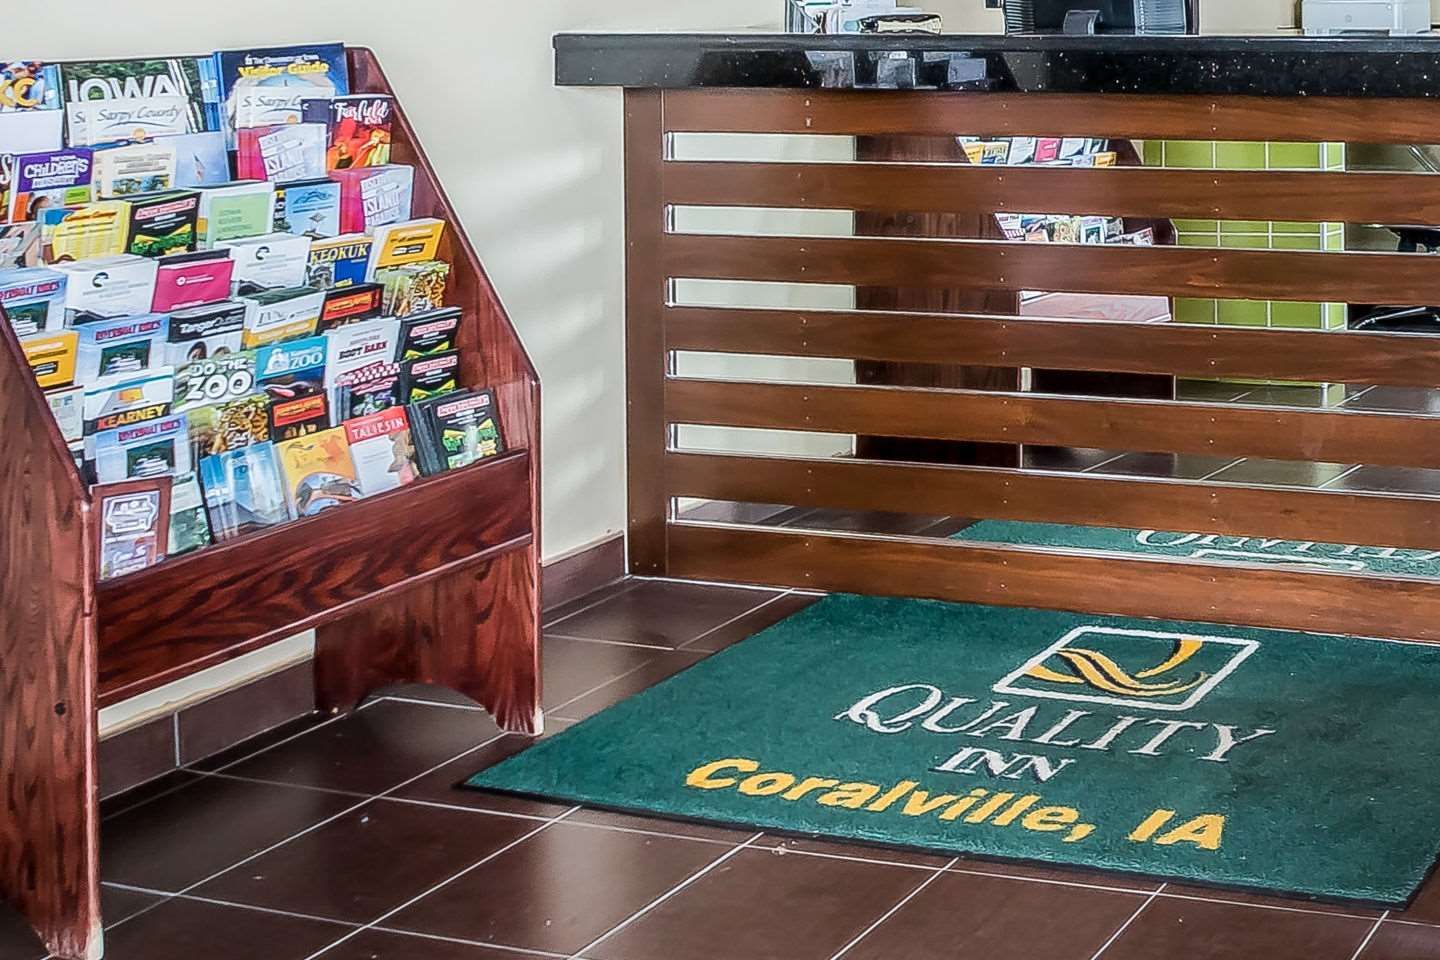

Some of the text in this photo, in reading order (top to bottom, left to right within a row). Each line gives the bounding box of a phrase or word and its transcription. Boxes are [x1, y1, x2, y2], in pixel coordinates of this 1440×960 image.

[68, 74, 181, 103] IOWA
[137, 105, 182, 123] County
[309, 243, 369, 265] KEOKUK
[191, 362, 216, 377] DO
[290, 352, 323, 369] ZOO
[185, 369, 254, 401] ZOO
[97, 405, 167, 430] KEARNEY
[351, 417, 404, 439] TALIESIN
[834, 682, 1277, 763] QUALITY
[934, 747, 1075, 783] INN
[686, 757, 1226, 851] Coralville, IA
